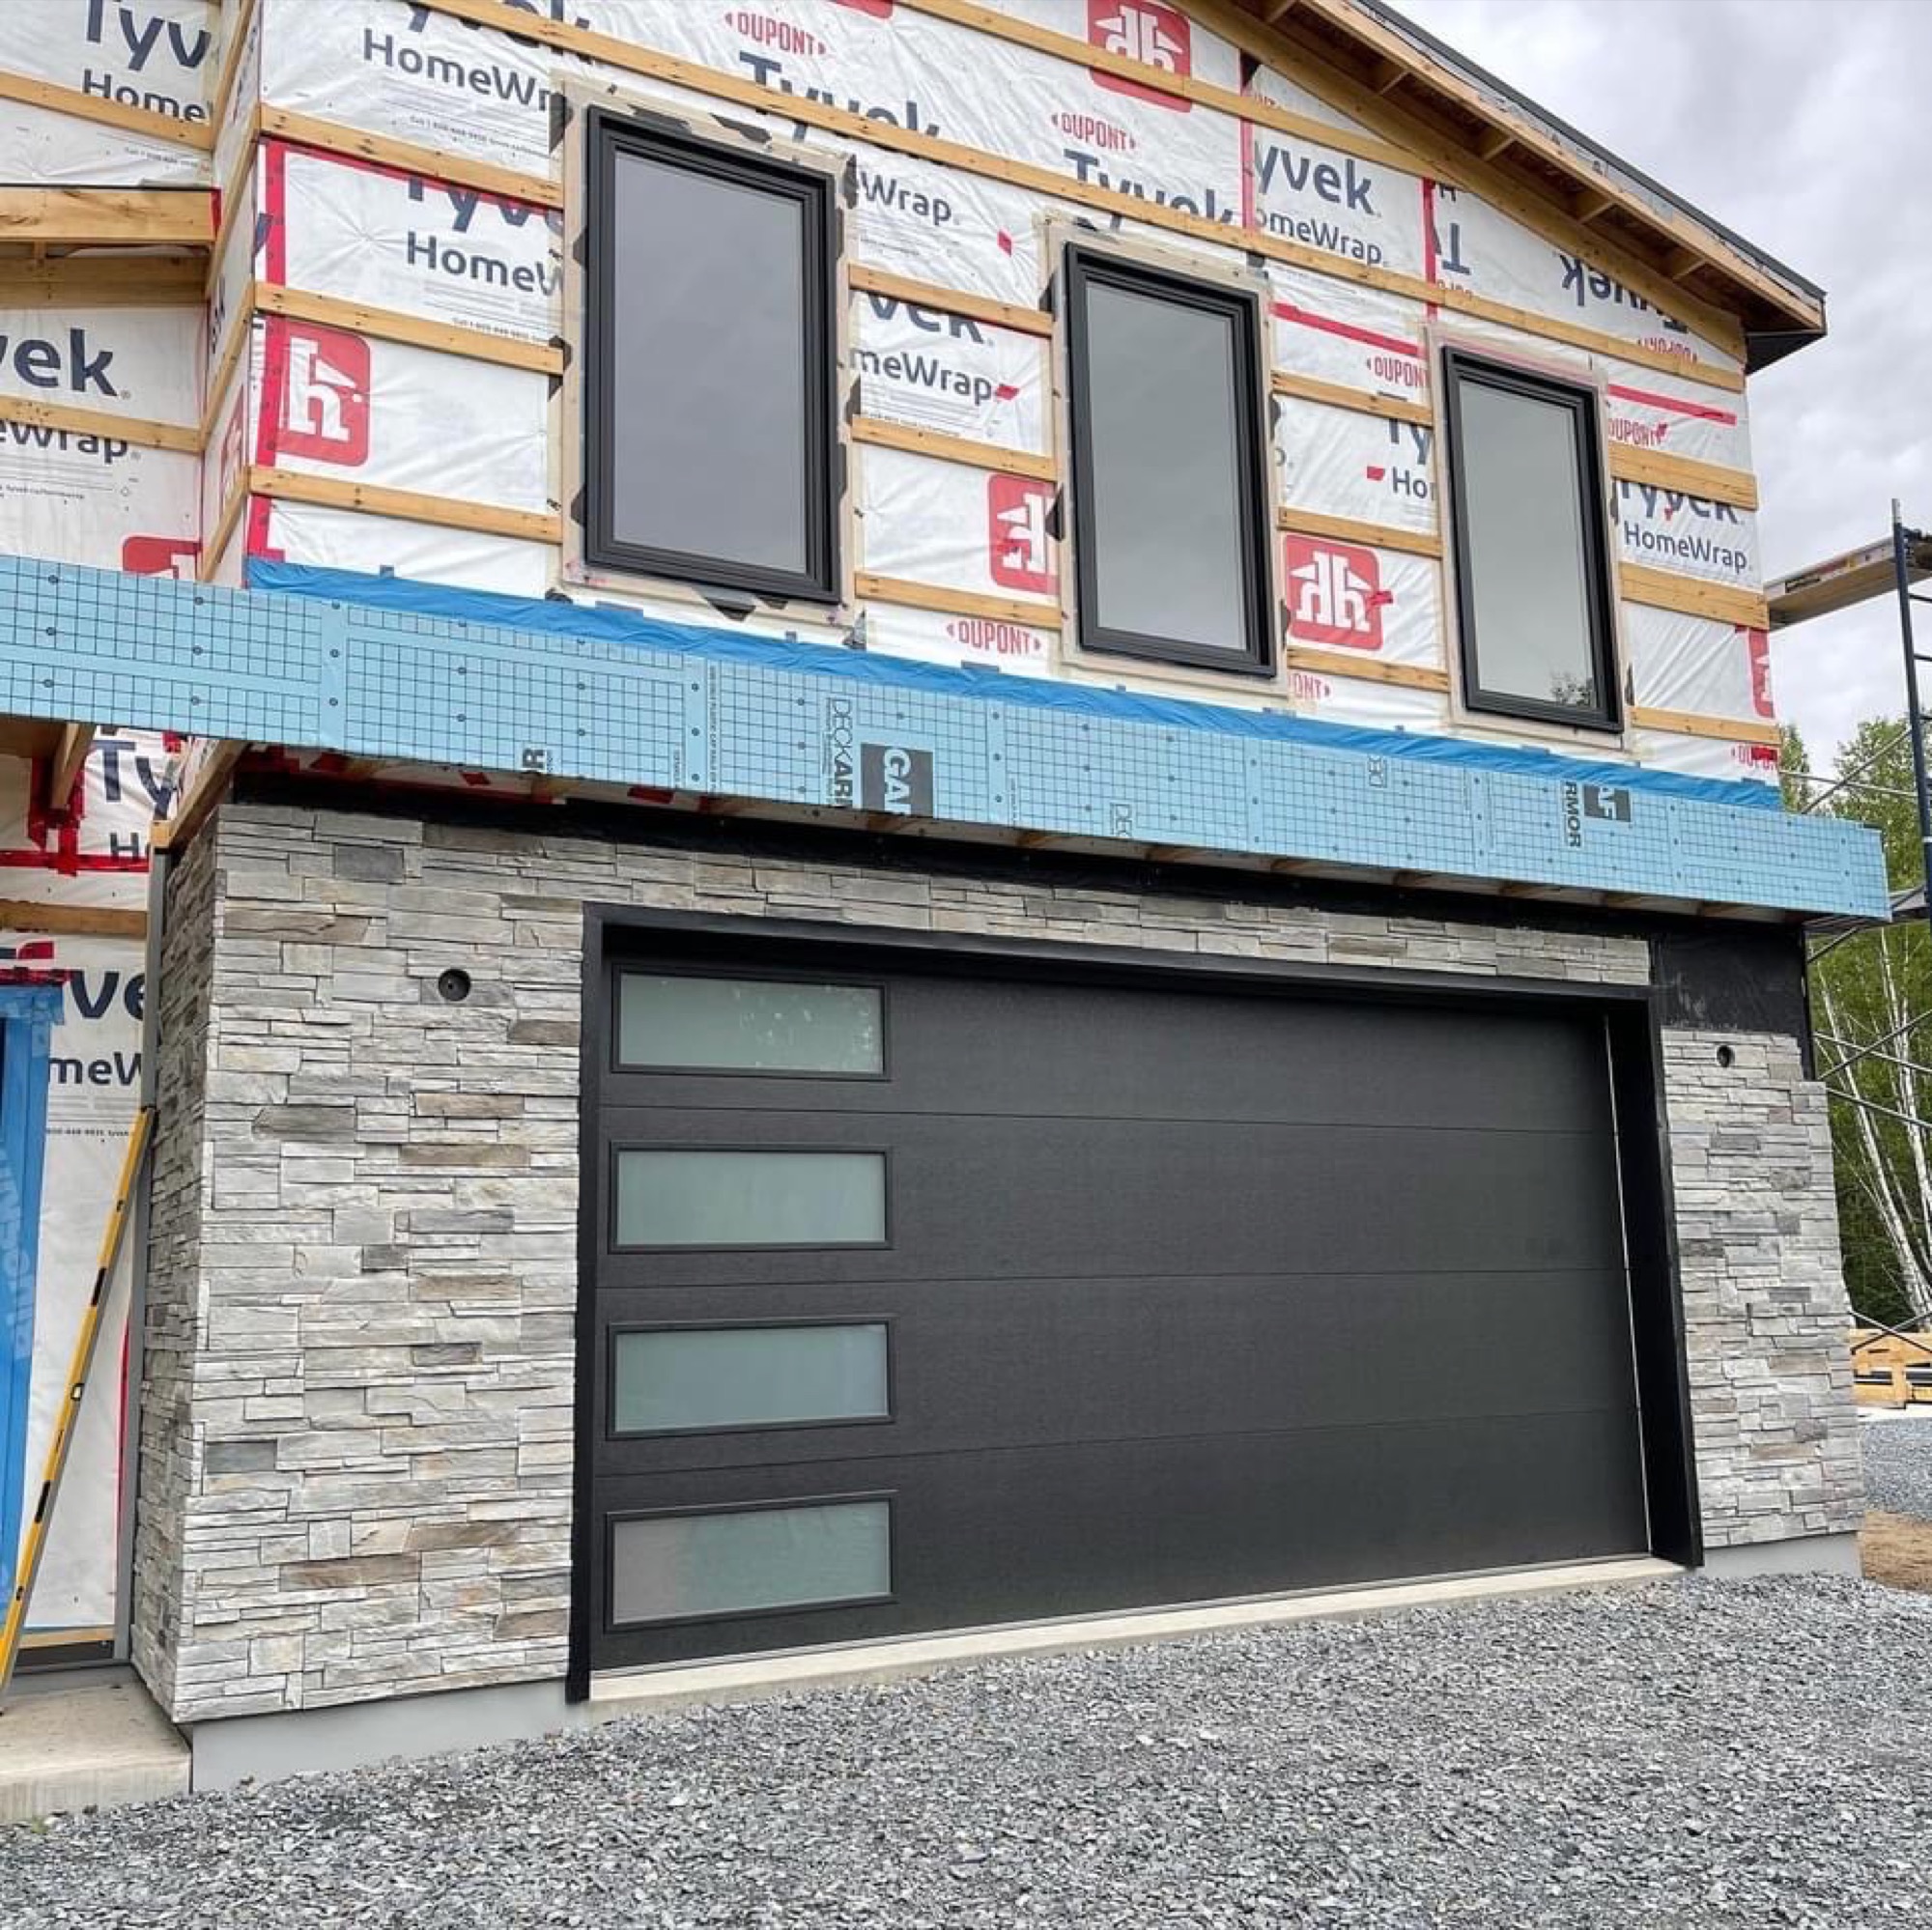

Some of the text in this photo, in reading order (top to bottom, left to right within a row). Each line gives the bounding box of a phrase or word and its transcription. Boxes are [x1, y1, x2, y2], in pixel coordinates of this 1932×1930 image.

[737, 12, 815, 55] DUPONT
[82, 69, 213, 122] Home
[1062, 112, 1127, 150] DUPONT
[0, 328, 118, 397] ek
[1624, 520, 1747, 575] HomeWrap
[957, 619, 1031, 655] DUPONT
